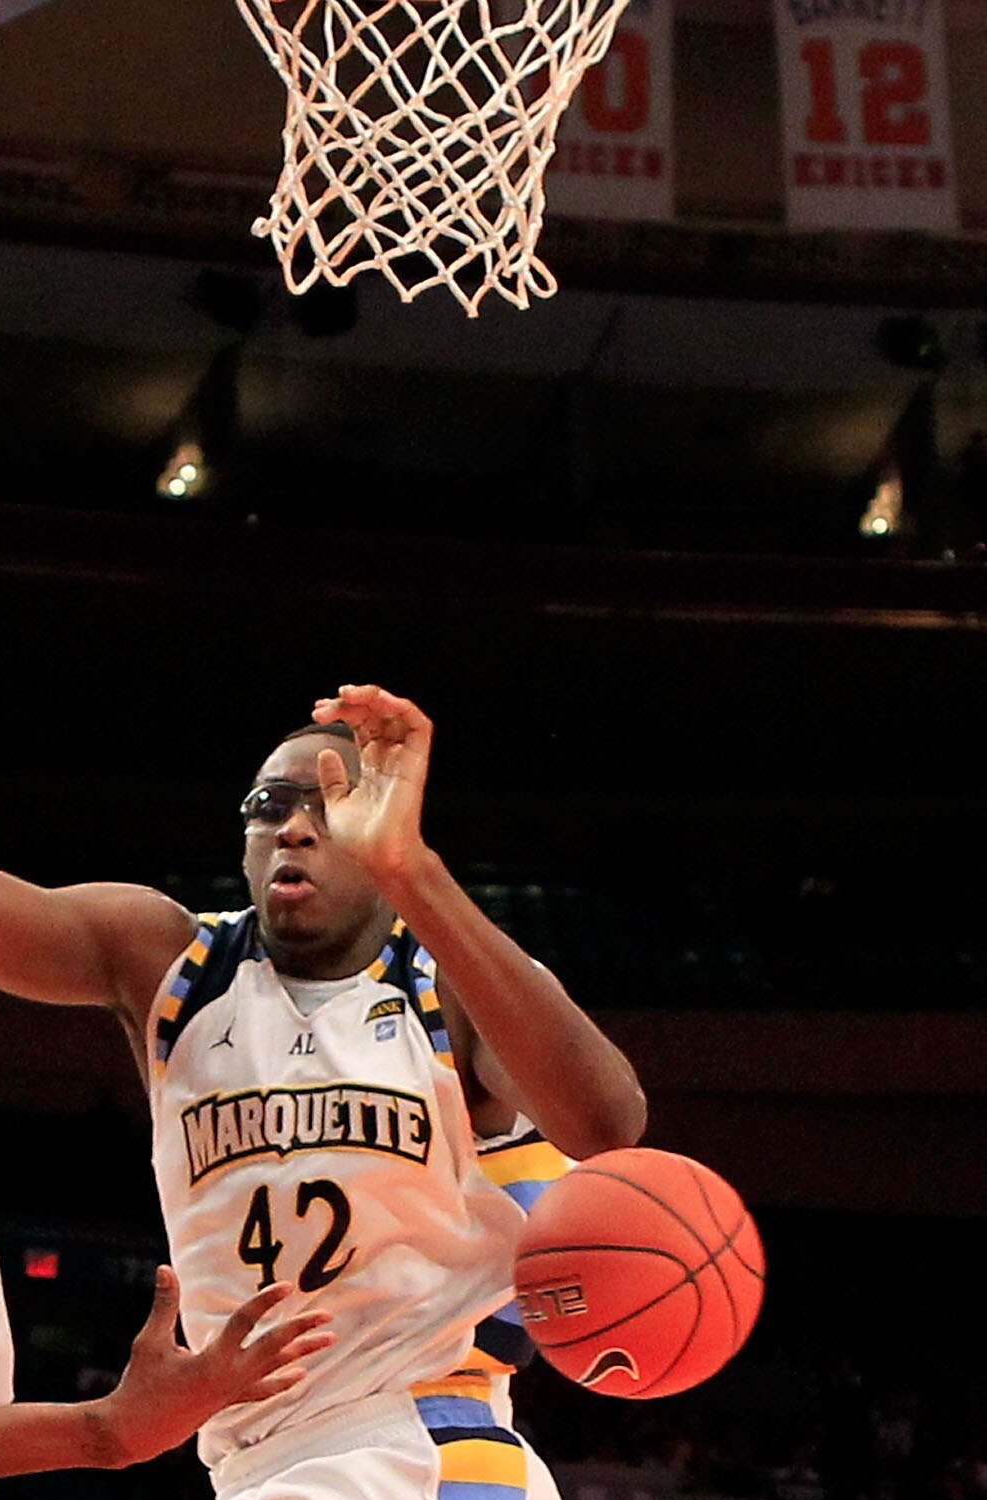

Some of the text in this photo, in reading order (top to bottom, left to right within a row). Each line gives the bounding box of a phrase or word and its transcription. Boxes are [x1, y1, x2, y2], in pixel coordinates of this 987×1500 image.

[800, 38, 931, 145] 12
[288, 1032, 316, 1055] AL
[181, 1085, 432, 1184] MARQUETTE
[237, 1179, 357, 1294] 42
